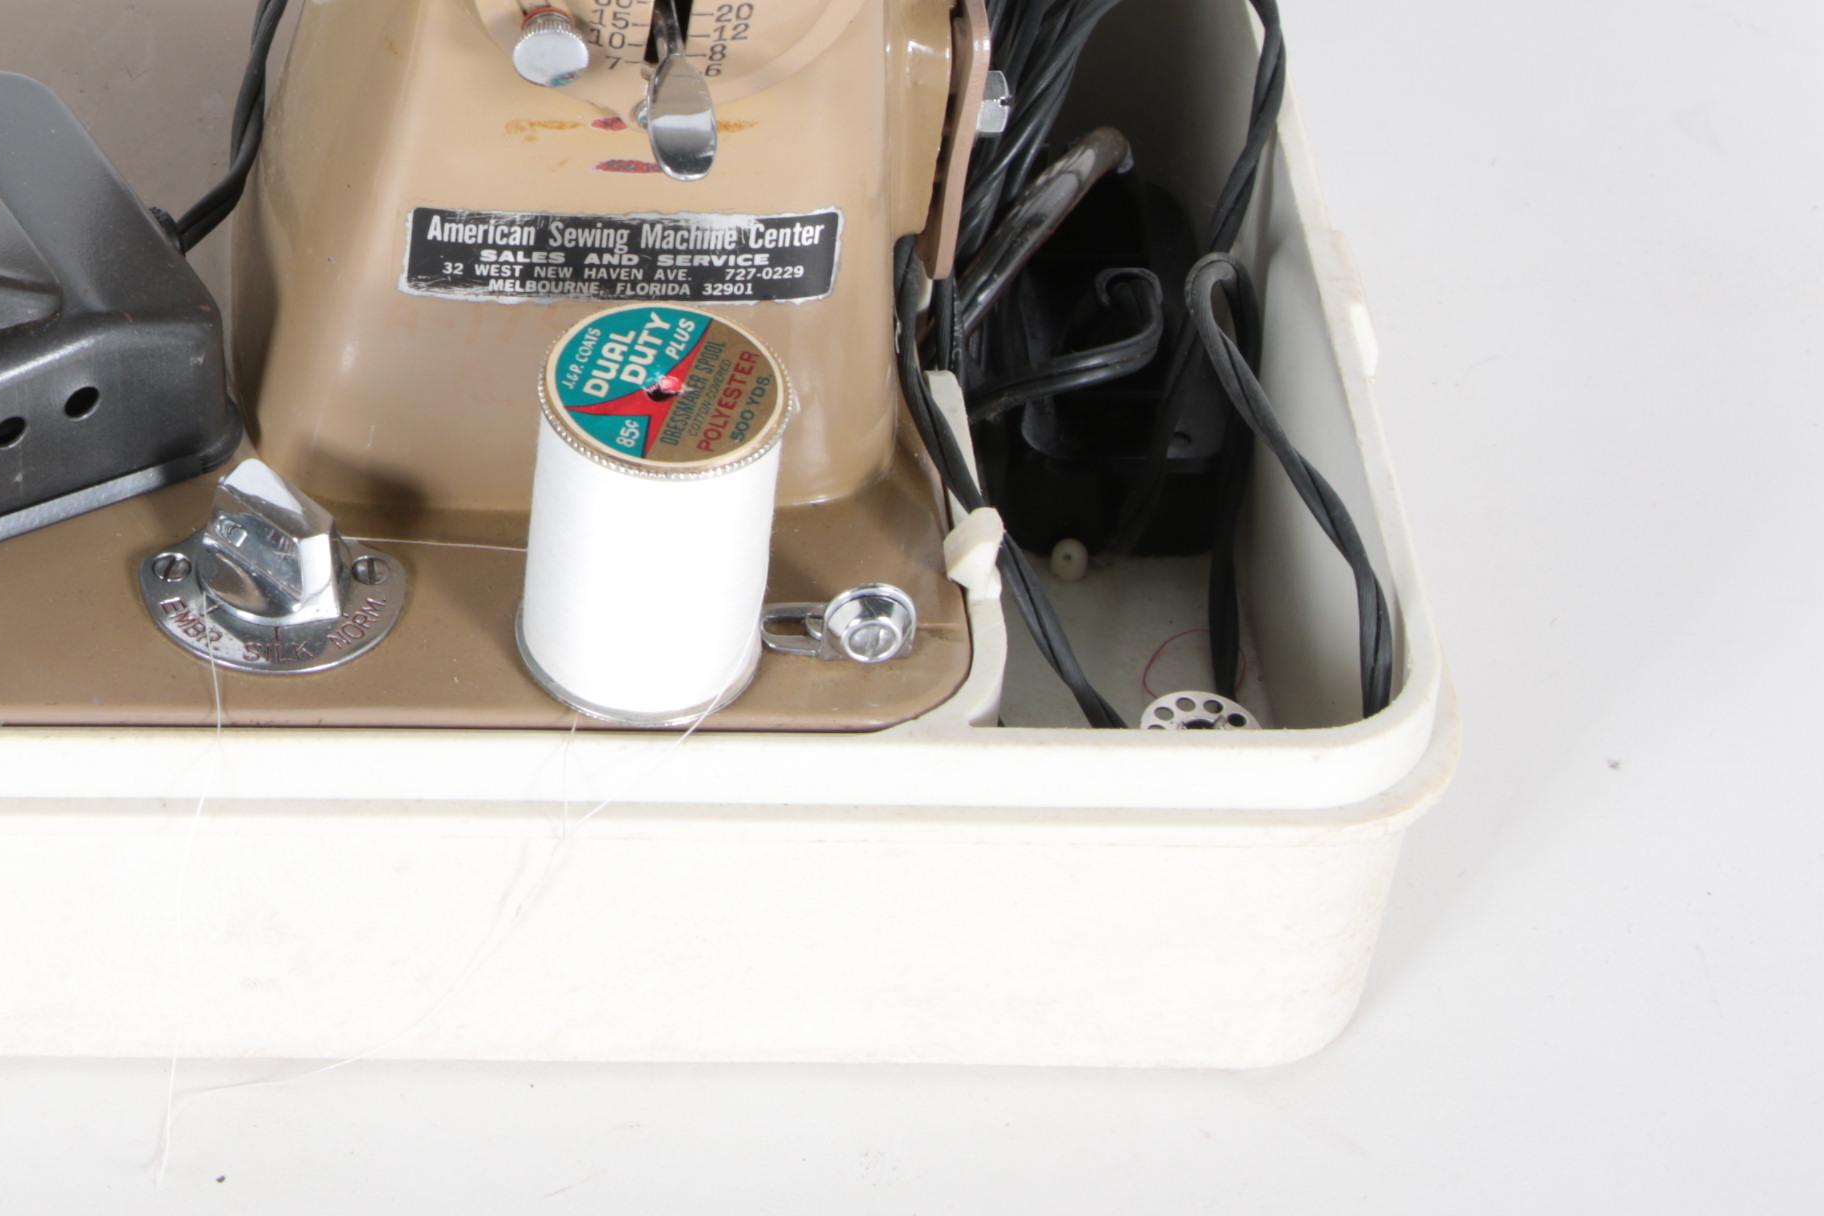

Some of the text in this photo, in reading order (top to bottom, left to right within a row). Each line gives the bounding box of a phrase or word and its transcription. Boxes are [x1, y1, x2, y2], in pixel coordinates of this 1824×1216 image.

[591, 8, 631, 30] 15
[715, 2, 754, 23] 20
[587, 28, 626, 50] 10
[713, 22, 750, 42] 12
[605, 55, 623, 70] 7
[708, 43, 727, 62] 8
[705, 63, 723, 77] 6
[427, 215, 825, 254] American Sewing Machine Center
[480, 249, 770, 267] SALES AND SERVICE
[442, 262, 804, 281] 32 WEST NEW HAVEN AVE. 727-0229
[616, 282, 690, 295] FLORIDA
[702, 283, 753, 295] 32901
[576, 328, 601, 363] COATS
[619, 311, 672, 386] DUTY
[665, 318, 695, 360] PLUS
[582, 330, 636, 398] DUAL
[660, 340, 726, 446] DRESSMAKER SPOOL
[696, 350, 761, 453] POLYESTER
[616, 419, 639, 448] 85¢
[730, 409, 755, 443] 500
[242, 640, 314, 663] SILK
[327, 596, 387, 649] NORM.
